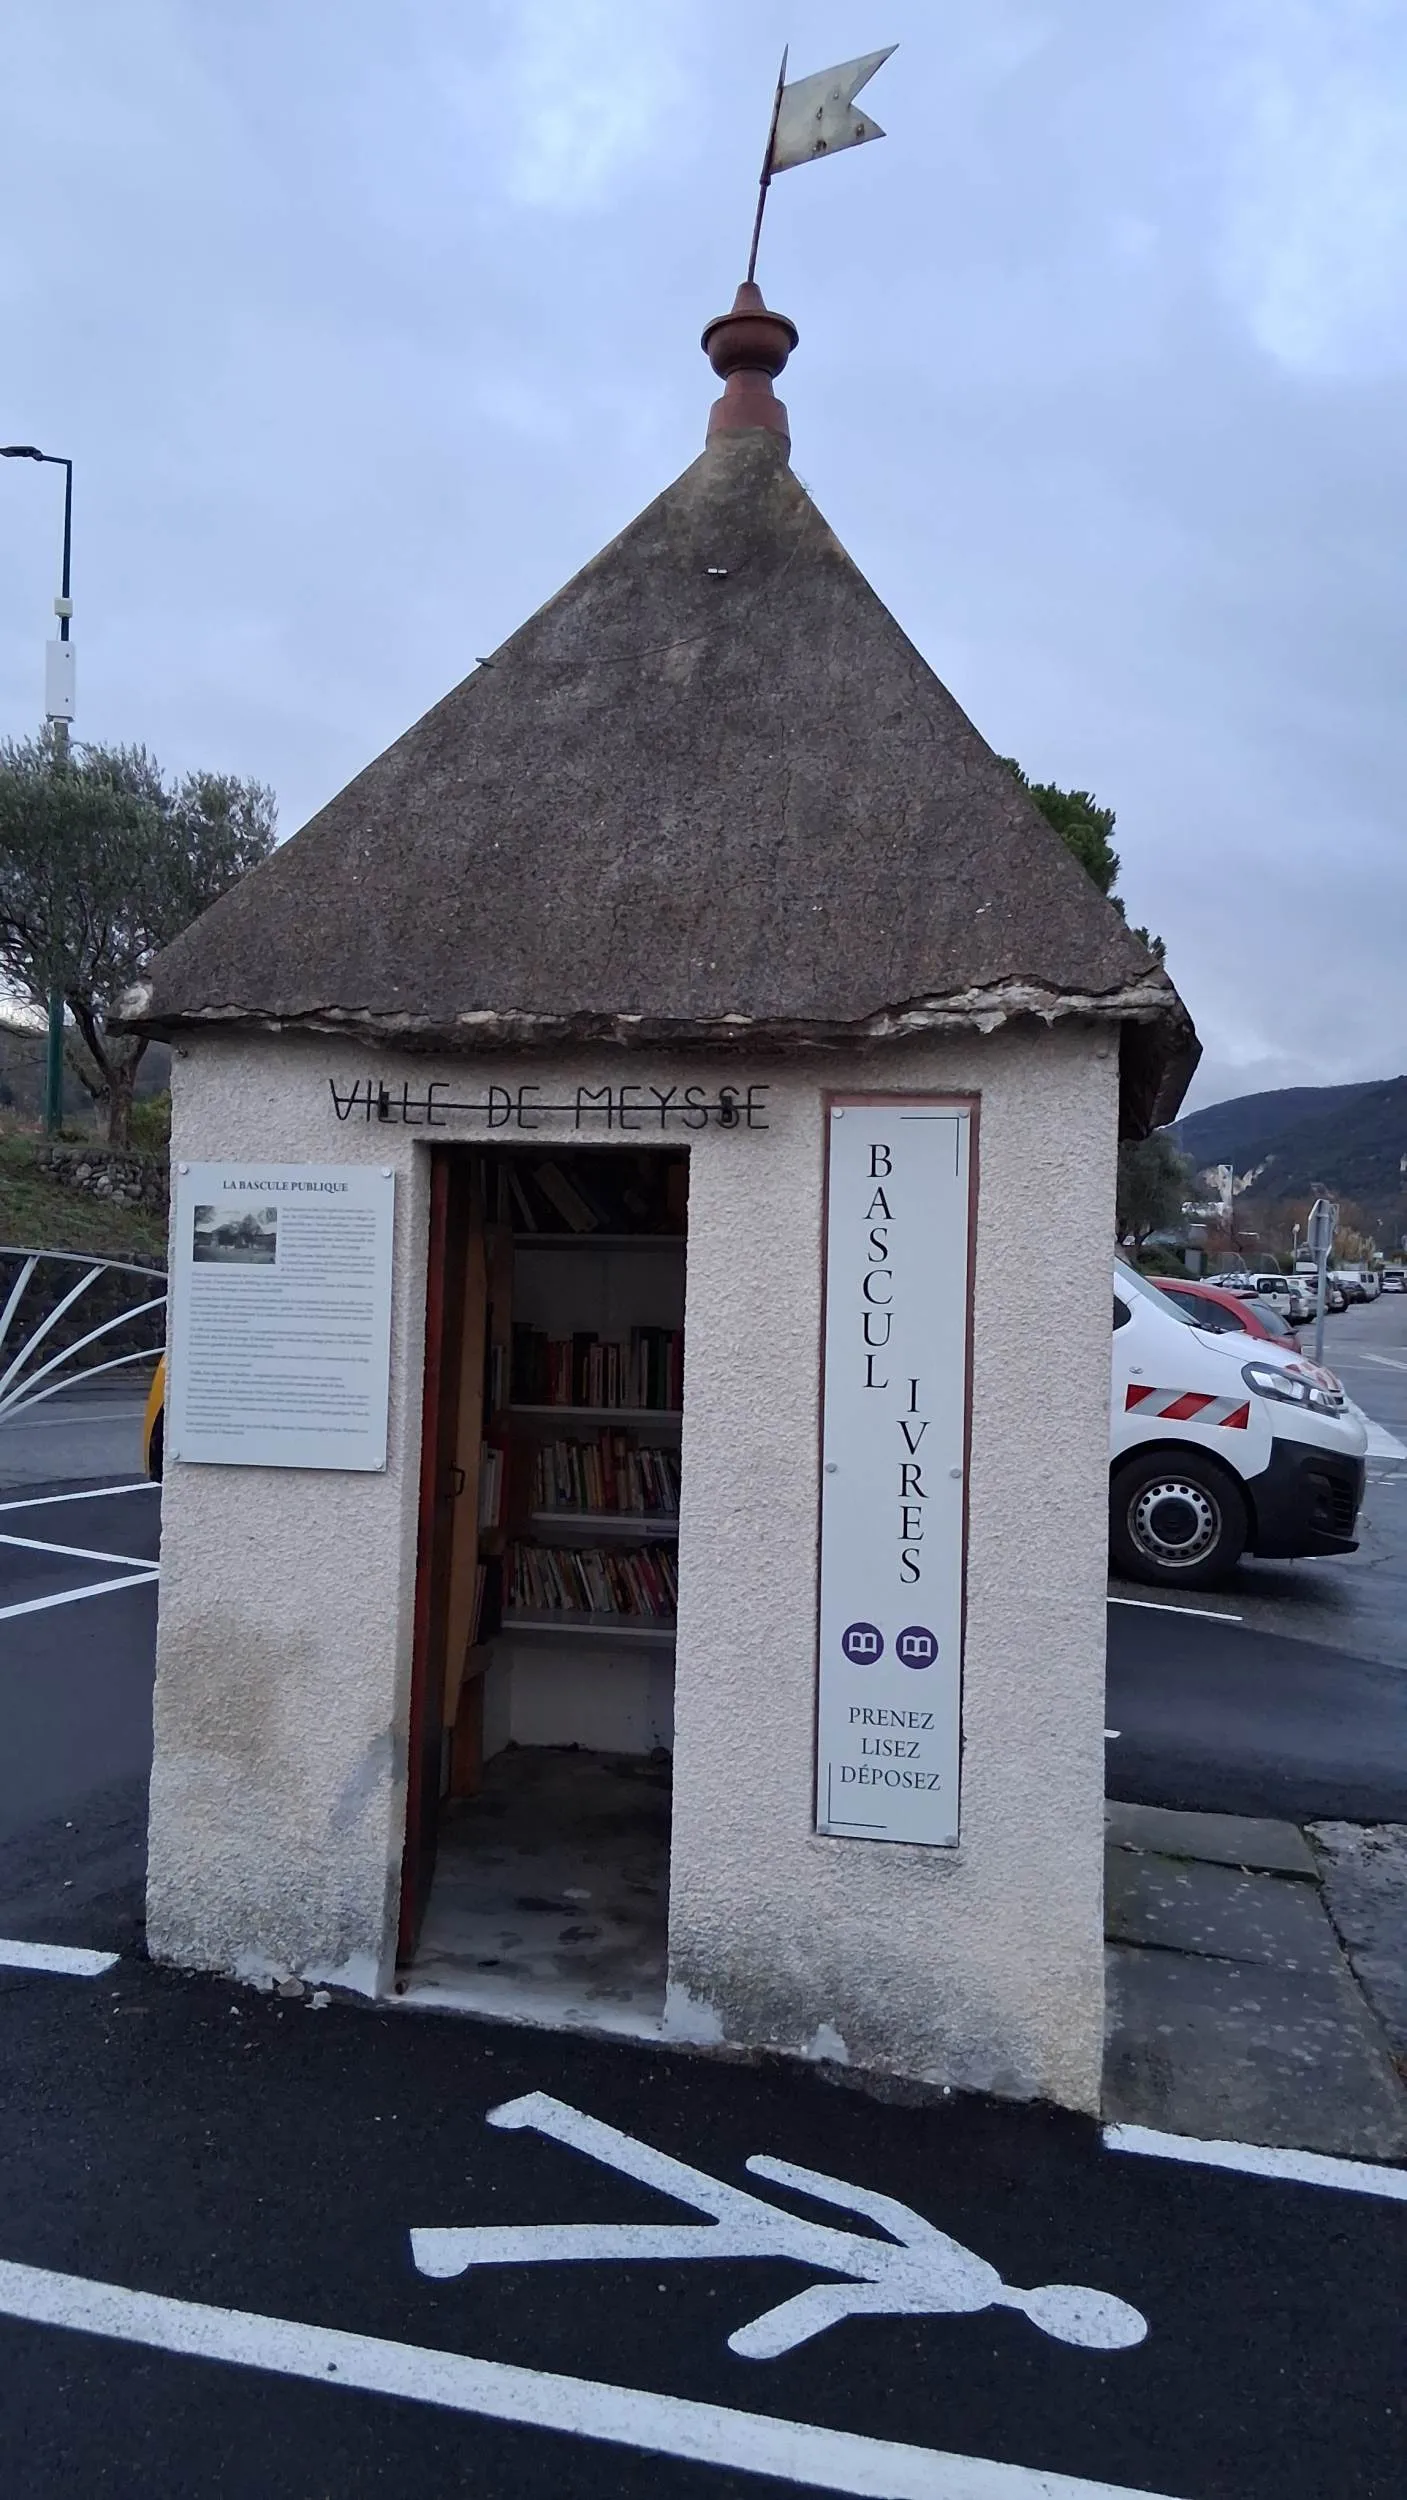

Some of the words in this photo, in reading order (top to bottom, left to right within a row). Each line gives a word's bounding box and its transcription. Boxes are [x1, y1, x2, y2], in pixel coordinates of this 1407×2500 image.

[329, 1078, 450, 1126] VILLE
[486, 1085, 540, 1129] DE
[575, 1085, 770, 1130] MEYSSE
[223, 1180, 236, 1190] LA
[239, 1181, 288, 1191] BASCULE
[291, 1182, 349, 1194] PUBLIQUE
[860, 1143, 896, 1389] BASCUL
[896, 1378, 931, 1584] IVRES
[848, 1706, 935, 1730] PRENEZ
[861, 1737, 921, 1759] LISEZ
[840, 1763, 941, 1791] DÉPOSEZ
